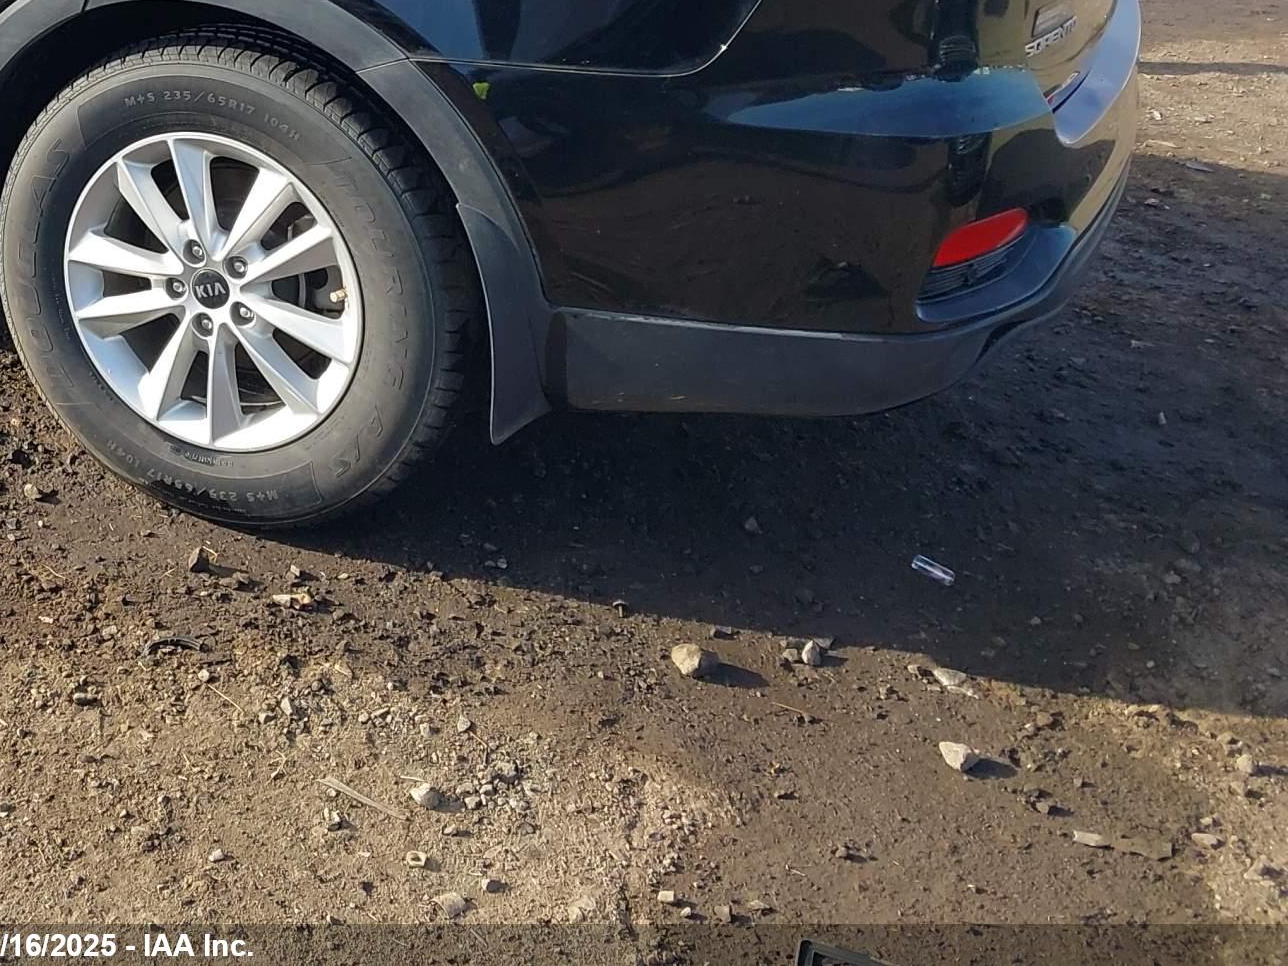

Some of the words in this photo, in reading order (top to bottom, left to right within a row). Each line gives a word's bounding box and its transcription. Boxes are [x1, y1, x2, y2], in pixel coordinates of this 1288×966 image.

[1024, 15, 1078, 59] SORENTO
[124, 91, 155, 108] M+S
[163, 90, 256, 115] 235/65R17
[194, 281, 227, 299] KIA
